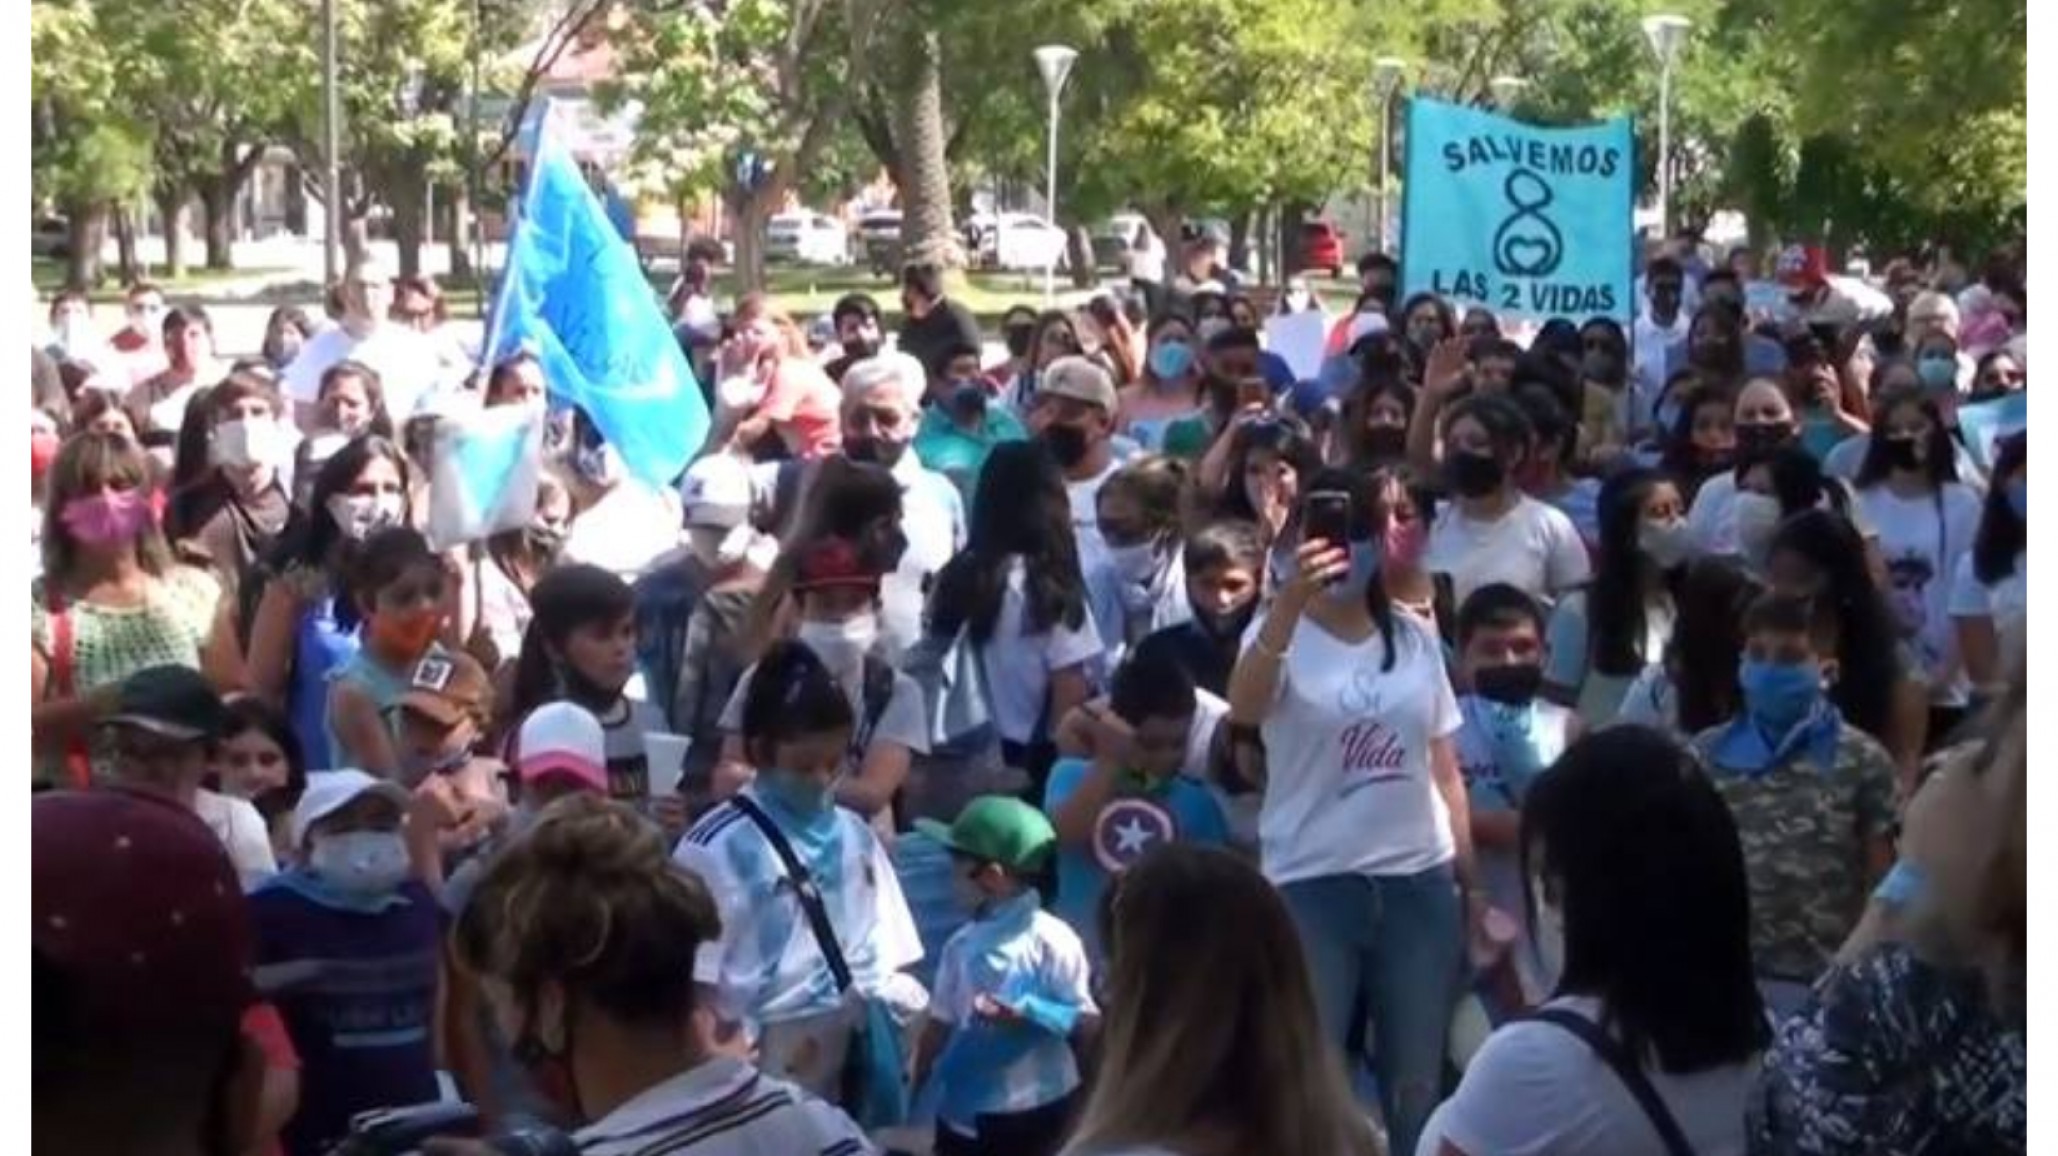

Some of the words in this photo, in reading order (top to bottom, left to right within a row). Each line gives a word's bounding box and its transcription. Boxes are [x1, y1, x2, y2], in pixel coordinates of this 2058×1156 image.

[1442, 134, 1621, 178] SALVEMOS
[1433, 269, 1489, 302] LAS
[1501, 284, 1521, 310] 2
[1530, 284, 1618, 313] VIDAS
[1340, 722, 1406, 773] Vida
